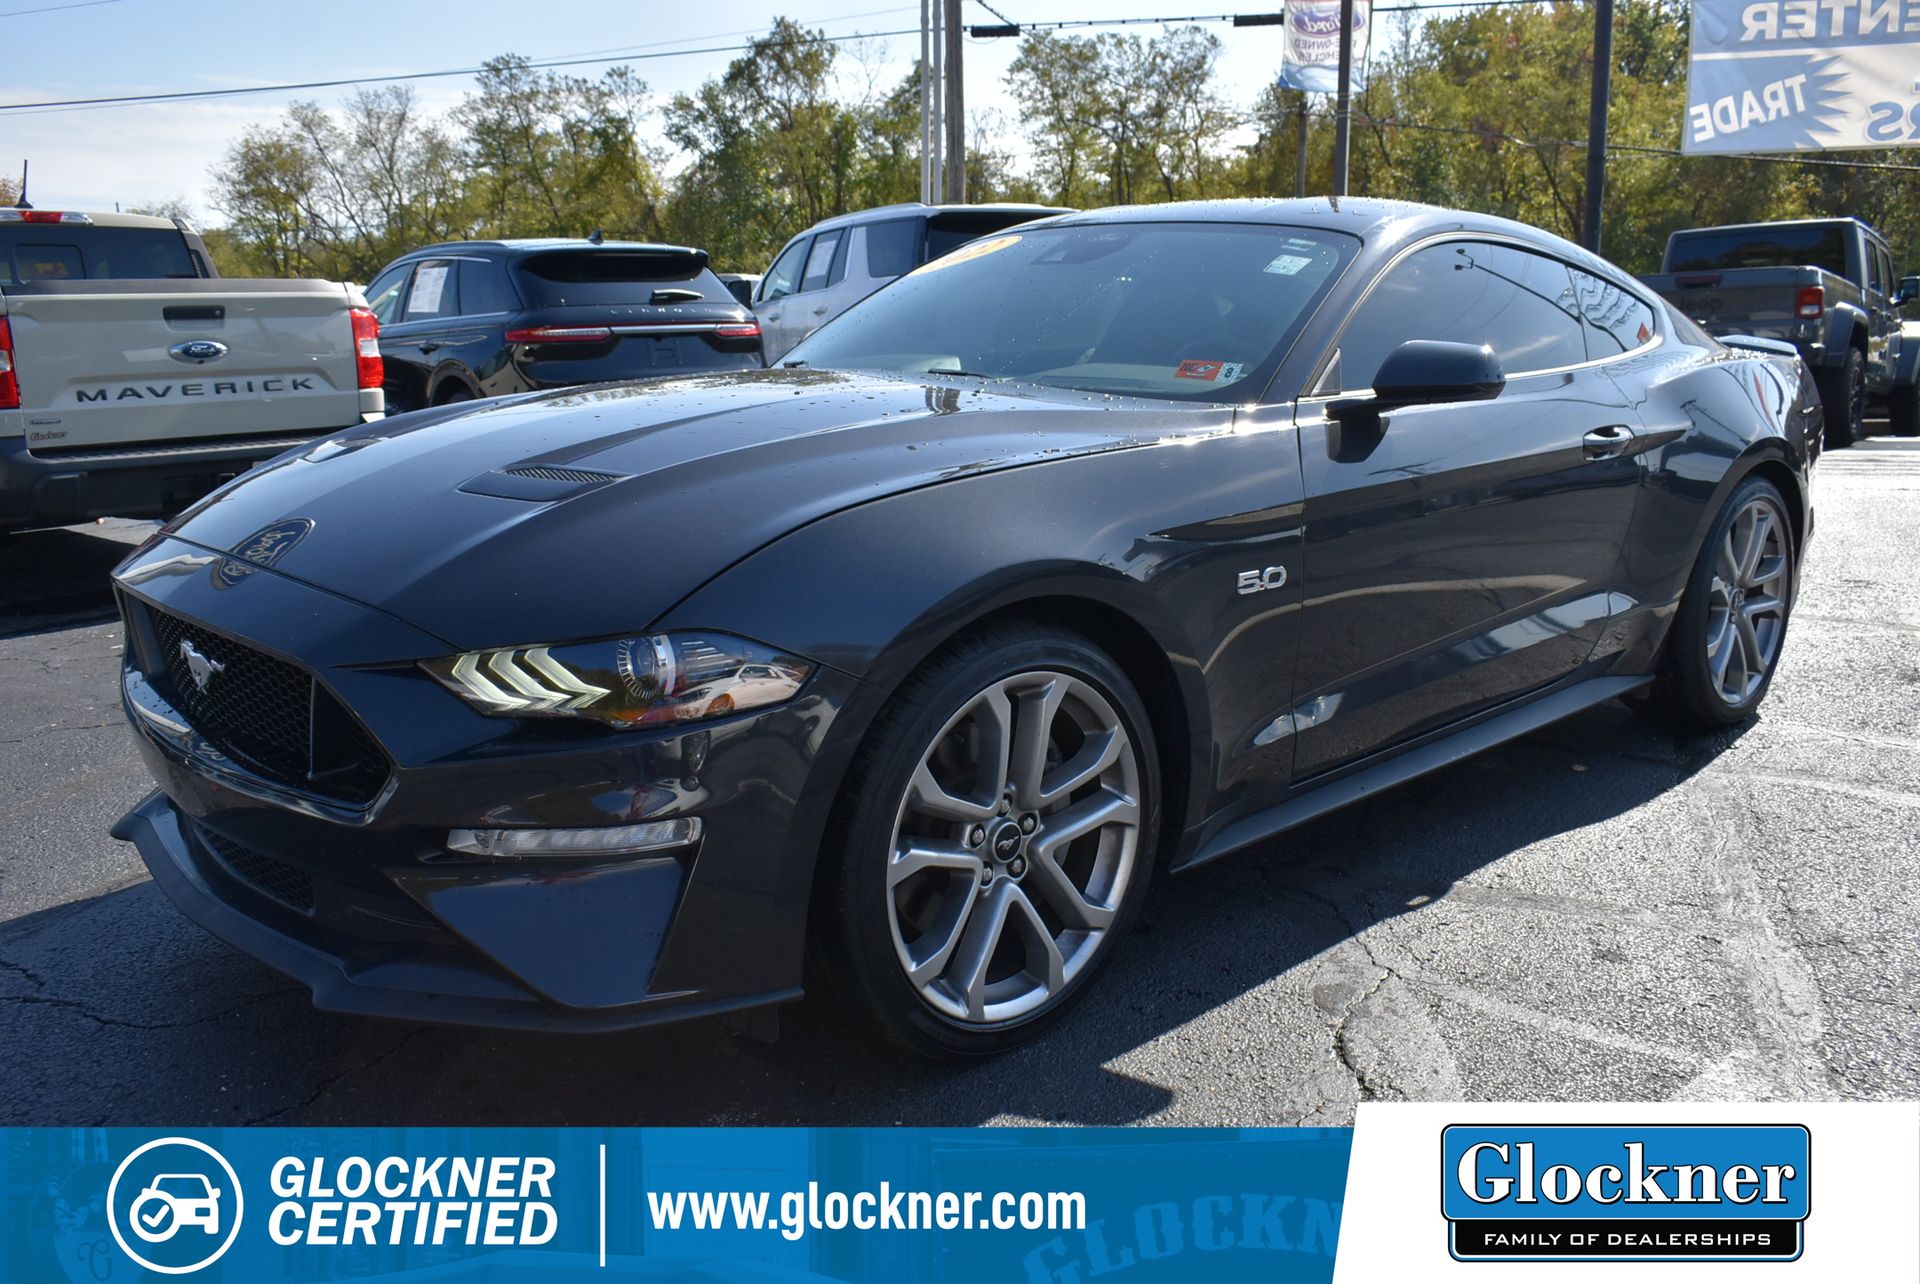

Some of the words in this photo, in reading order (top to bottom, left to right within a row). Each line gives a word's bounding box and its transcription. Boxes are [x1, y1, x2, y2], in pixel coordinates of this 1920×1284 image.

[1224, 367, 1234, 378] 8
[76, 378, 314, 403] MAVERICK
[1237, 565, 1287, 595] 5.0
